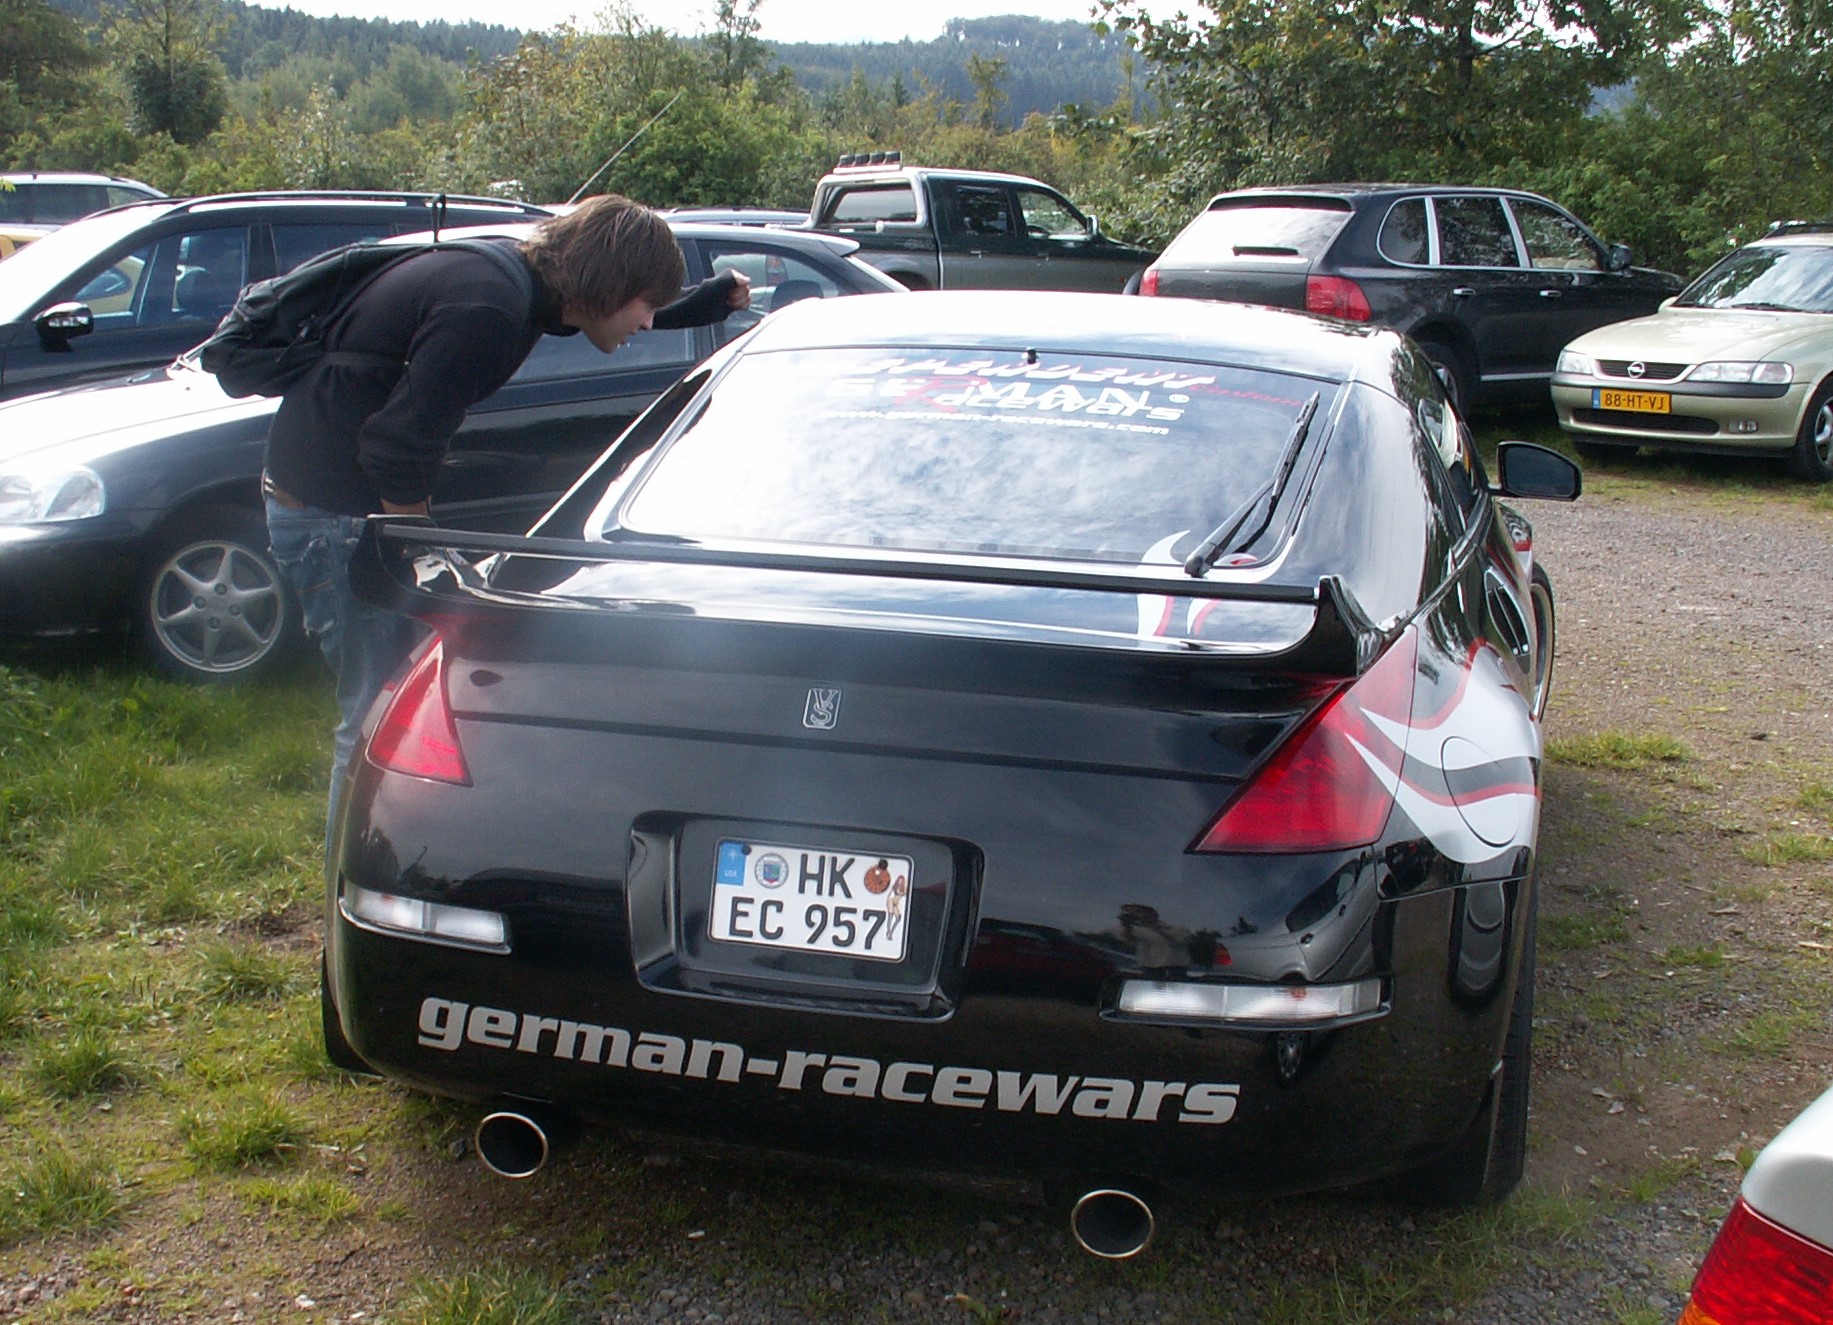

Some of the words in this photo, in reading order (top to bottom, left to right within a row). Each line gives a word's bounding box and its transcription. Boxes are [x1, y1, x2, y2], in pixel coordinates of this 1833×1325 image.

[1604, 392, 1665, 410] 88-HT-VJ
[798, 853, 856, 898] HK
[728, 896, 784, 940] EC
[804, 903, 887, 950] 957
[416, 995, 1241, 1125] german-racewars
